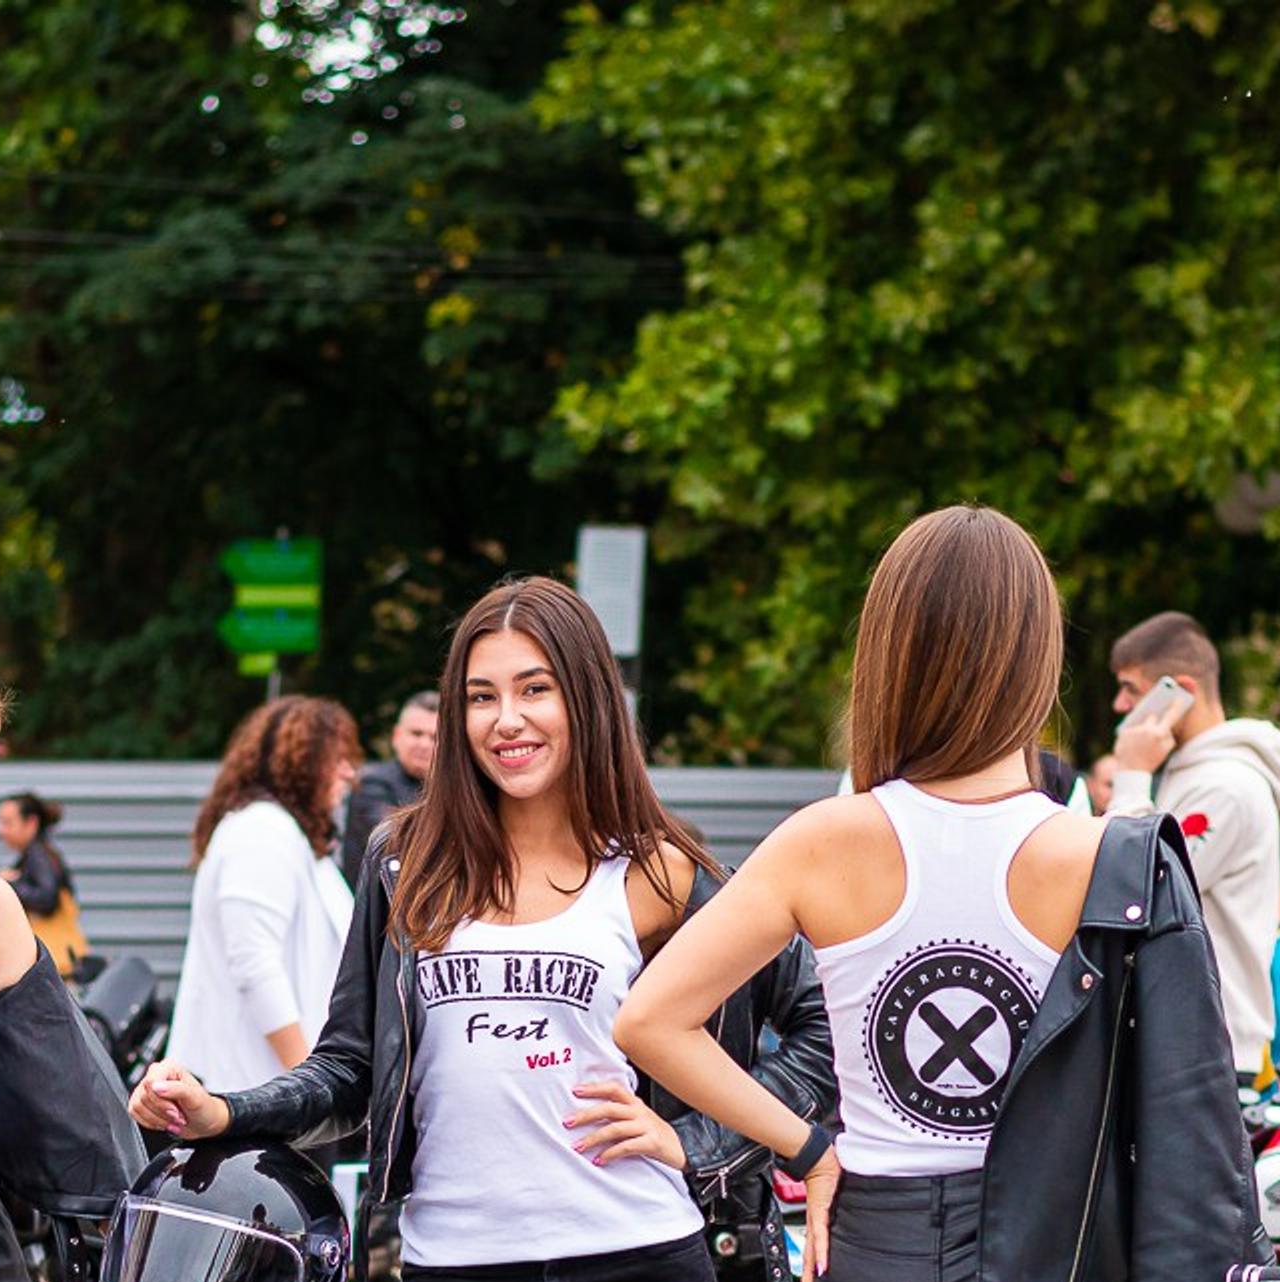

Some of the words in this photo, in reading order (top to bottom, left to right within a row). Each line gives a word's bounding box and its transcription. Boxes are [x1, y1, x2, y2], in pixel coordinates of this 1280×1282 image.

[417, 957, 481, 1001] CAFE
[504, 956, 599, 1004] RACER
[883, 986, 916, 1042] CAFE
[919, 965, 995, 987] RACER
[1000, 989, 1030, 1044] CLU
[466, 1013, 548, 1043] Fest
[526, 1052, 560, 1069] Vol.
[563, 1048, 572, 1063] 2
